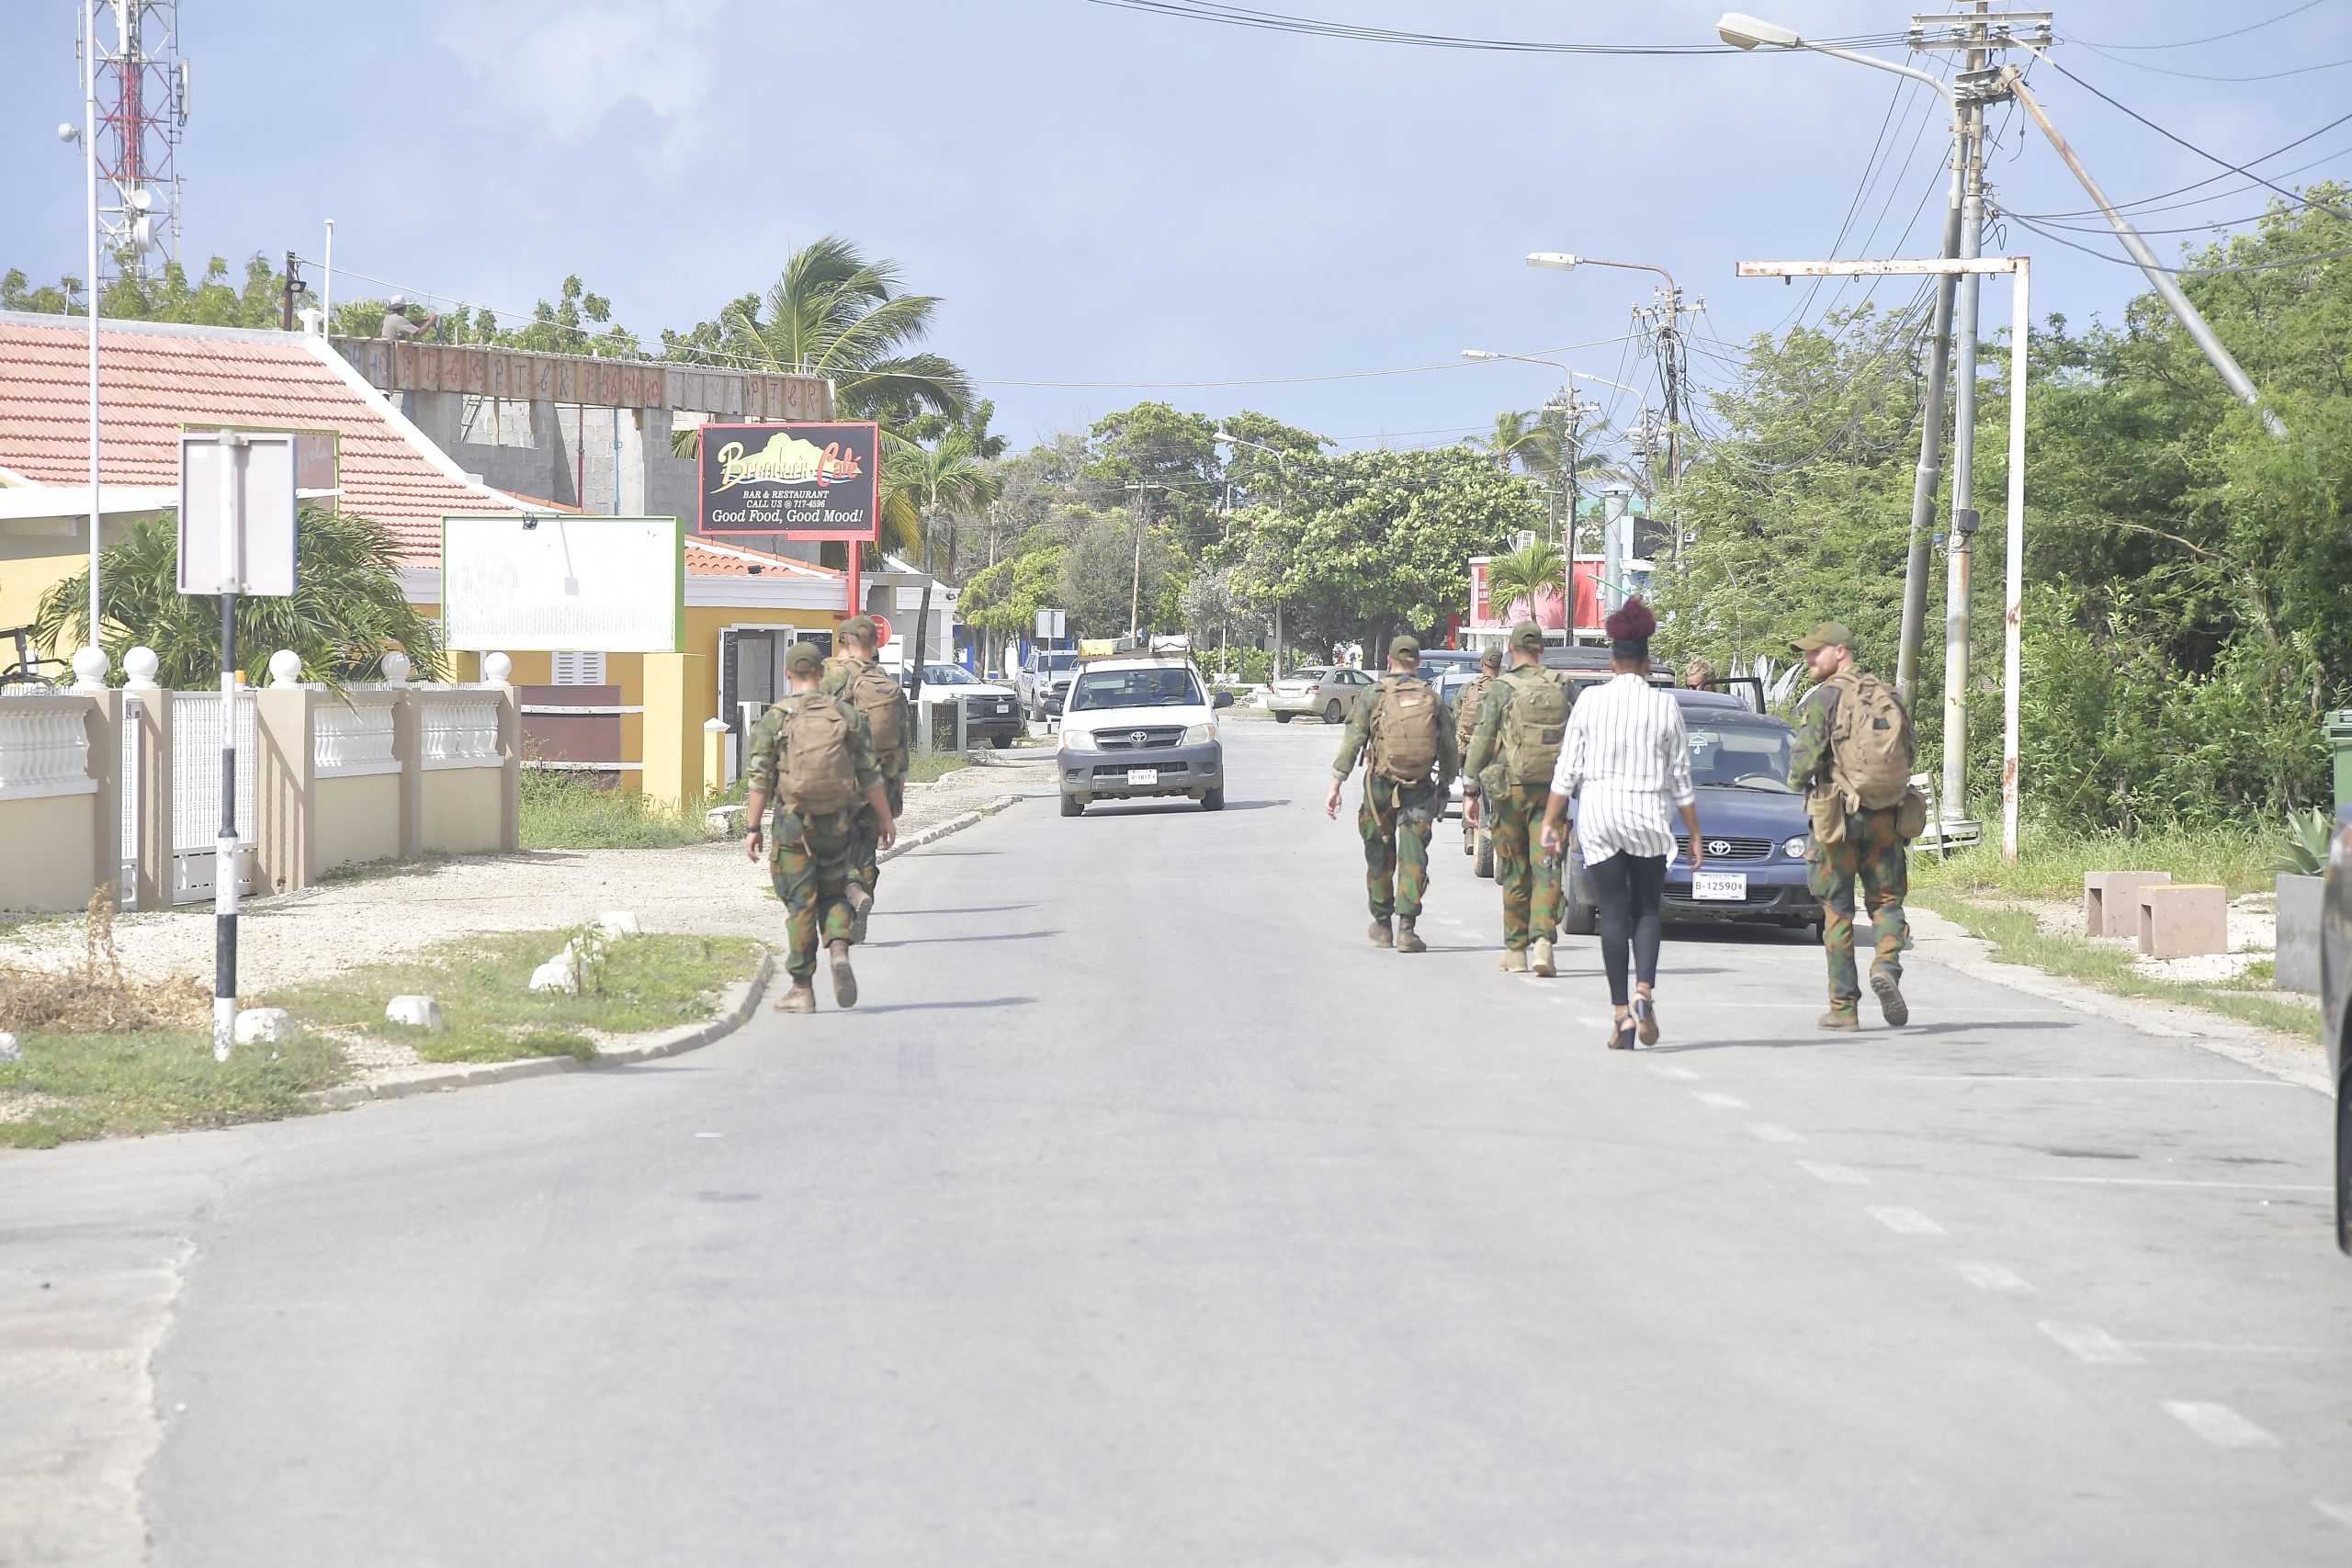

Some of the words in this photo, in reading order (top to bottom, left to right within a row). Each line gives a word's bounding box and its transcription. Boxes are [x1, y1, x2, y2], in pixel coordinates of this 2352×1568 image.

[709, 441, 814, 493] Brandaris
[817, 441, 862, 487] Café
[742, 491, 762, 499] BAR
[763, 491, 770, 499] &
[772, 491, 830, 499] RESTAURANT
[746, 500, 769, 508] CALL
[771, 500, 783, 508] US
[784, 500, 792, 509] @
[794, 500, 825, 508] 717-4596
[712, 509, 746, 523] Good
[749, 509, 783, 525] Food,
[786, 509, 820, 523] Good
[822, 509, 864, 523] Mood!
[1695, 882, 1737, 891] B-12590
